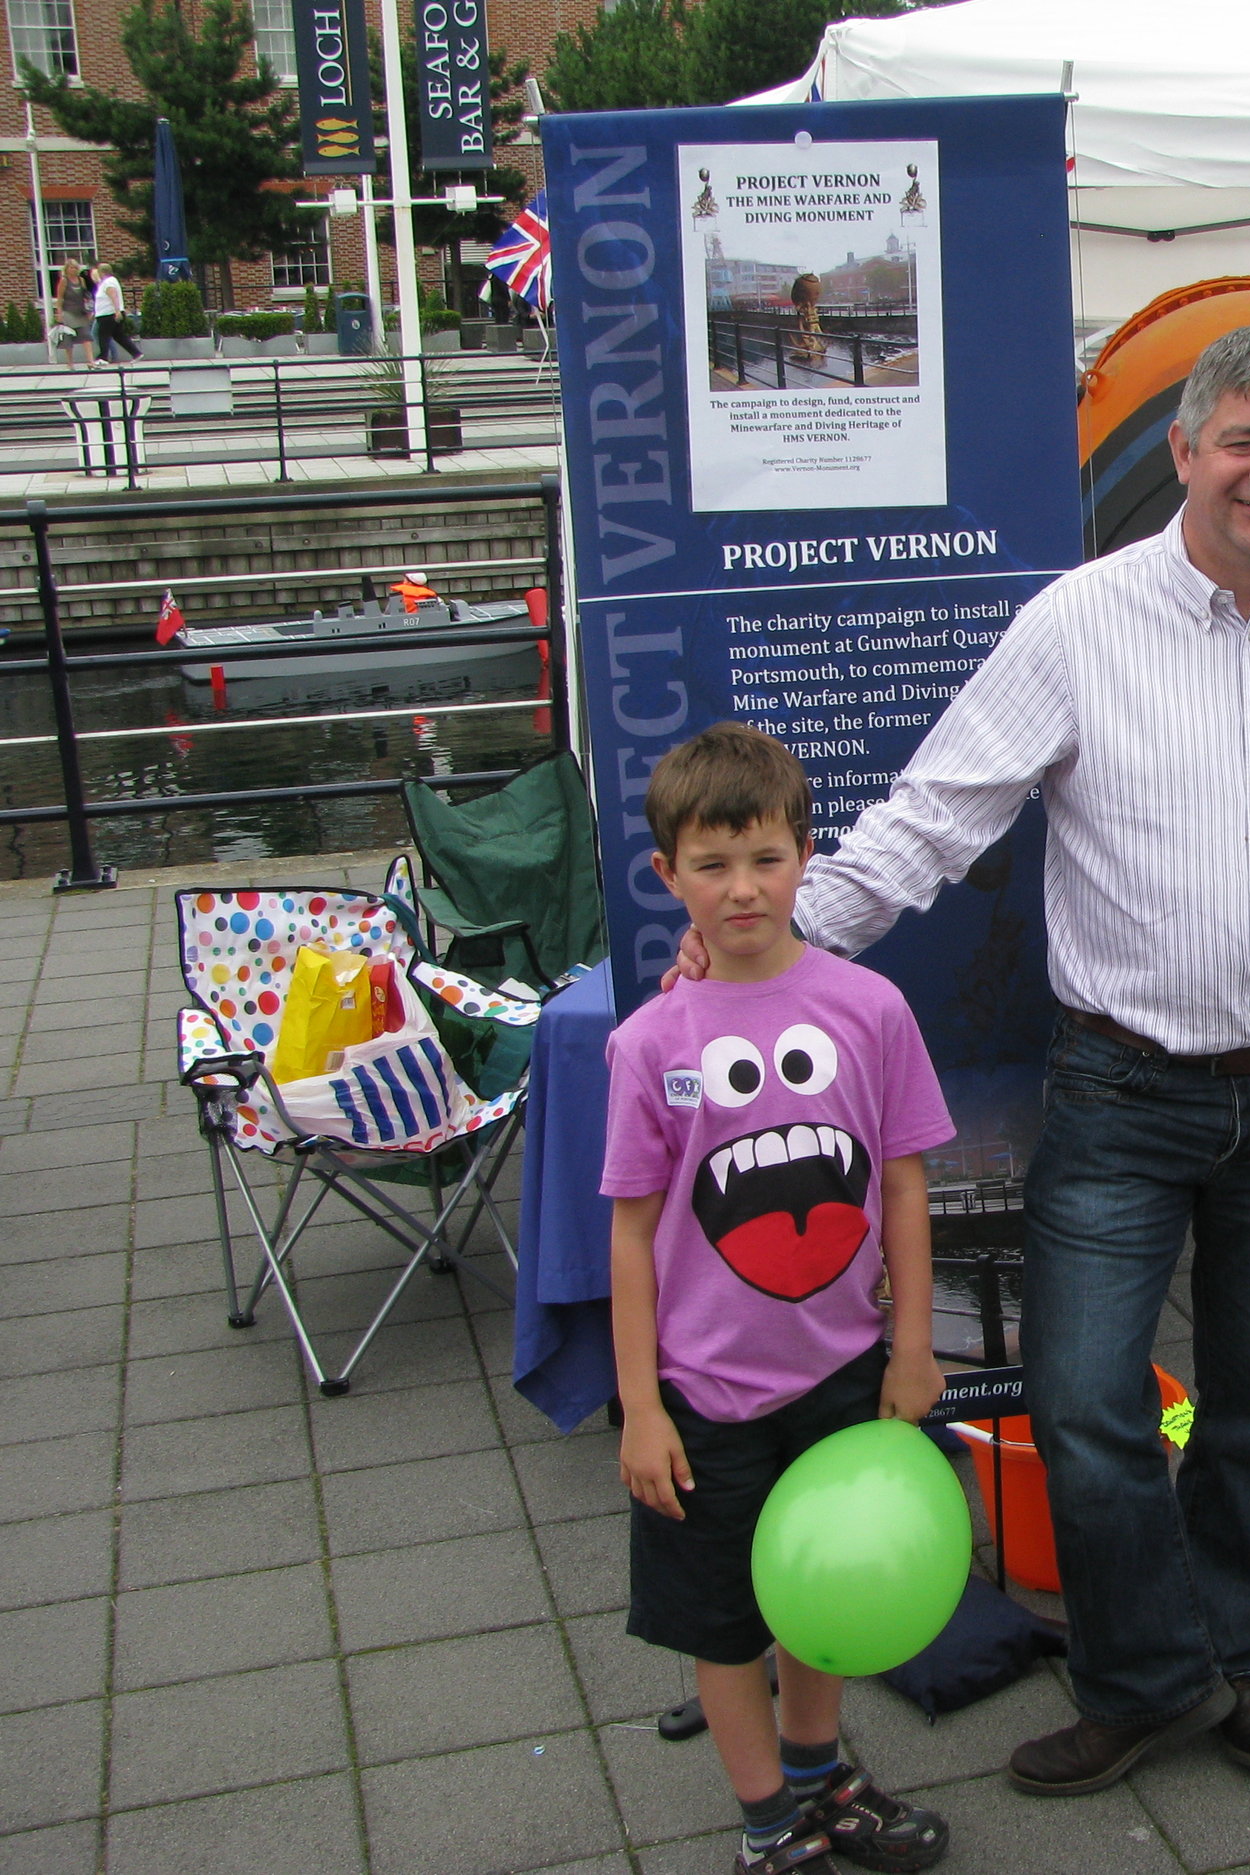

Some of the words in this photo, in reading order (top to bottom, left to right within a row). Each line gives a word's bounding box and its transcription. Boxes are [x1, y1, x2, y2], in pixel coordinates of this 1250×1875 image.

[313, 8, 347, 107] LOCH
[423, 0, 453, 119] SEAFO
[455, 37, 480, 71] &
[458, 80, 485, 154] BAR
[736, 175, 808, 191] PROJECT
[812, 174, 881, 188] VERNON
[726, 196, 754, 207] THE
[757, 195, 792, 207] MINE
[794, 194, 861, 206] WARFARE
[863, 193, 892, 205] AND
[745, 212, 792, 224] DIVING
[795, 210, 874, 222] MONUMENT
[569, 143, 677, 586] VERNON
[710, 400, 729, 409] The
[730, 400, 778, 410] campaign
[779, 399, 790, 407] to
[791, 398, 826, 408] design,
[828, 396, 852, 406] fund,
[854, 396, 901, 405] construct
[902, 395, 920, 404] and
[729, 412, 760, 421] install
[761, 412, 768, 420] a
[770, 411, 823, 419] monument
[824, 408, 872, 417] dedicated
[873, 408, 884, 416] to
[885, 407, 902, 416] the
[730, 422, 793, 433] Minewarfare
[794, 422, 813, 431] and
[815, 421, 847, 431] Diving
[848, 420, 890, 431] Heritage
[891, 419, 902, 428] of
[783, 433, 804, 443] HMS
[806, 433, 851, 442] VERNON.
[762, 457, 794, 465] Registered
[722, 537, 858, 573] PROJECT
[866, 529, 998, 562] VERNON
[403, 617, 420, 627] R07
[726, 615, 762, 634] The
[767, 612, 832, 634] charity
[837, 608, 926, 629] campaign
[930, 607, 949, 620] to
[954, 600, 1010, 620] install
[729, 640, 829, 660] monument
[835, 638, 853, 653] at
[857, 630, 950, 653] Gunwharf
[731, 662, 845, 686] Portsmouth,
[849, 664, 868, 679] to
[733, 694, 779, 711] Mine
[783, 687, 858, 709] Warfare
[862, 685, 896, 702] and
[901, 682, 960, 703] Diving
[757, 718, 787, 735] the
[791, 716, 829, 735] site,
[833, 715, 863, 731] the
[867, 711, 931, 730] former
[784, 739, 870, 759] VERNON.
[828, 769, 902, 788] informa
[808, 825, 856, 840] erno
[938, 1380, 1023, 1401] ment.org
[925, 1406, 956, 1419] 28677
